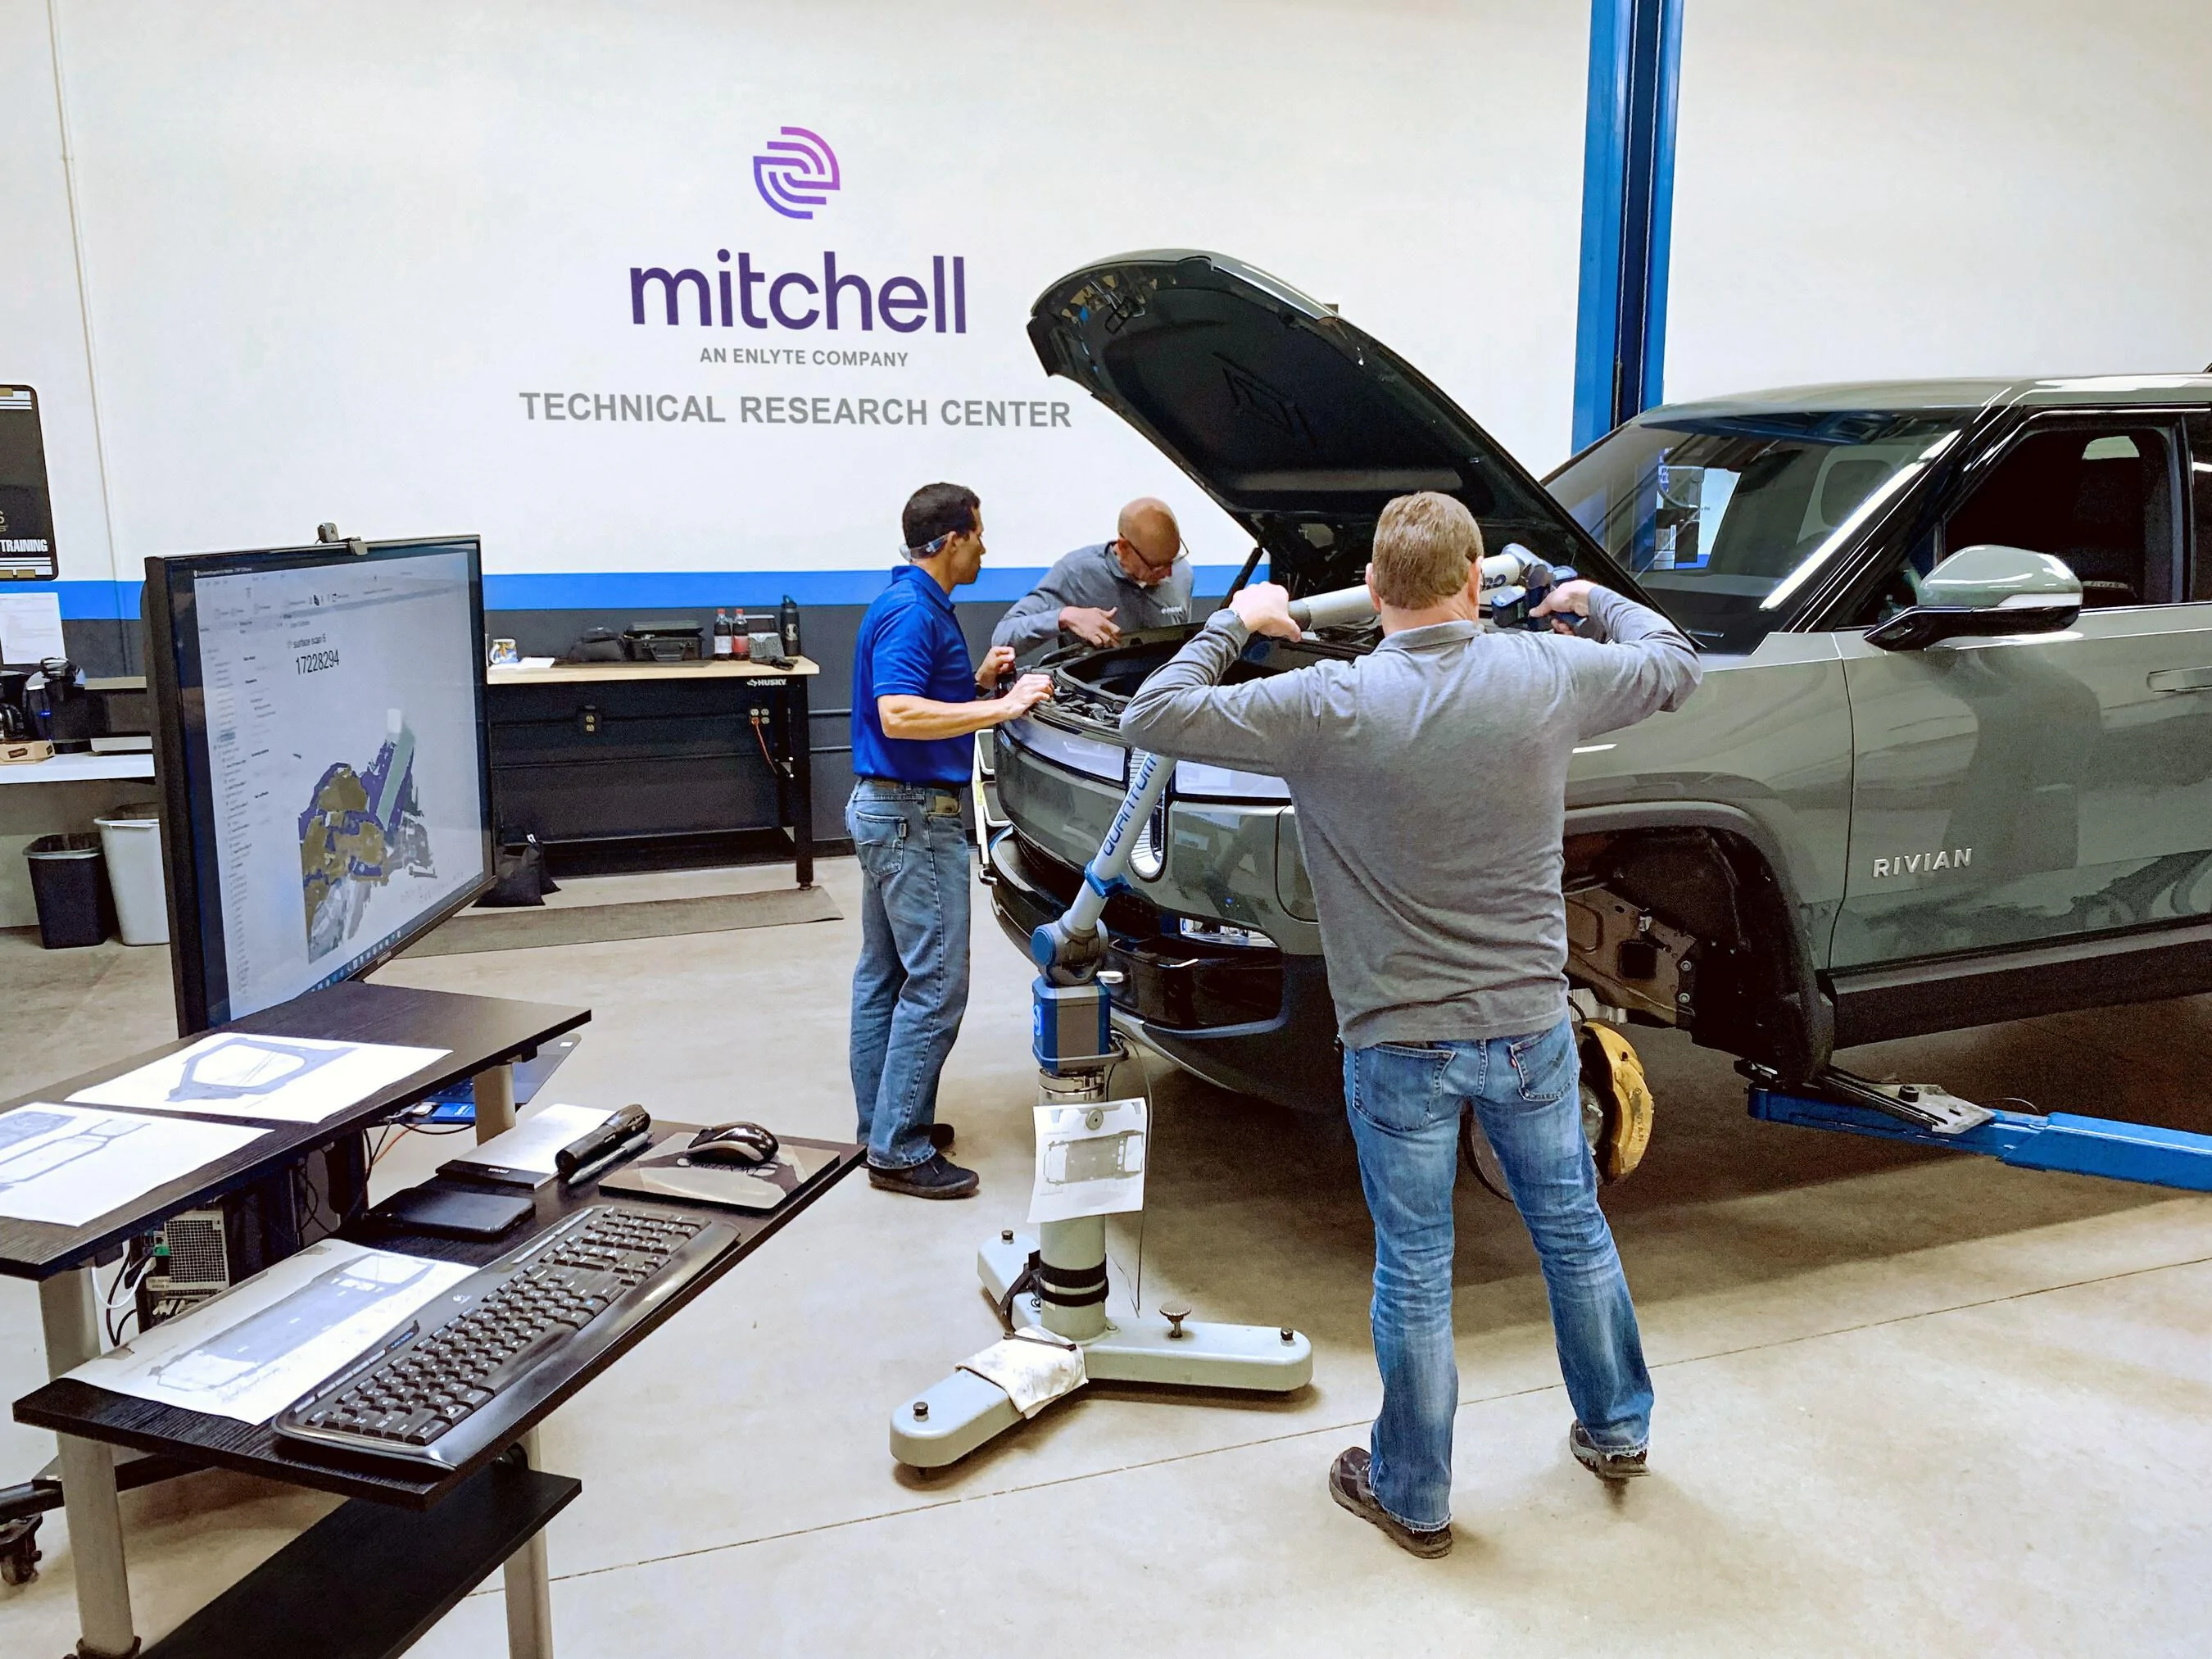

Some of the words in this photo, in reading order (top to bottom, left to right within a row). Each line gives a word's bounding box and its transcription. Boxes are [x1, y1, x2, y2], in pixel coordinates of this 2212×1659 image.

[630, 249, 967, 334] mitchell
[700, 348, 727, 363] AN
[733, 348, 806, 365] ENLYTE
[813, 351, 909, 367] COMPANY
[519, 392, 726, 424] TECHNICAL
[740, 397, 927, 426] RESEARCH
[941, 400, 1072, 428] CENTER
[0, 538, 48, 552] TRAINING
[296, 649, 340, 675] 17228294
[758, 678, 787, 687] HUSKY
[1103, 755, 1158, 857] QUANTUM
[1872, 848, 1973, 878] RIVIAN
